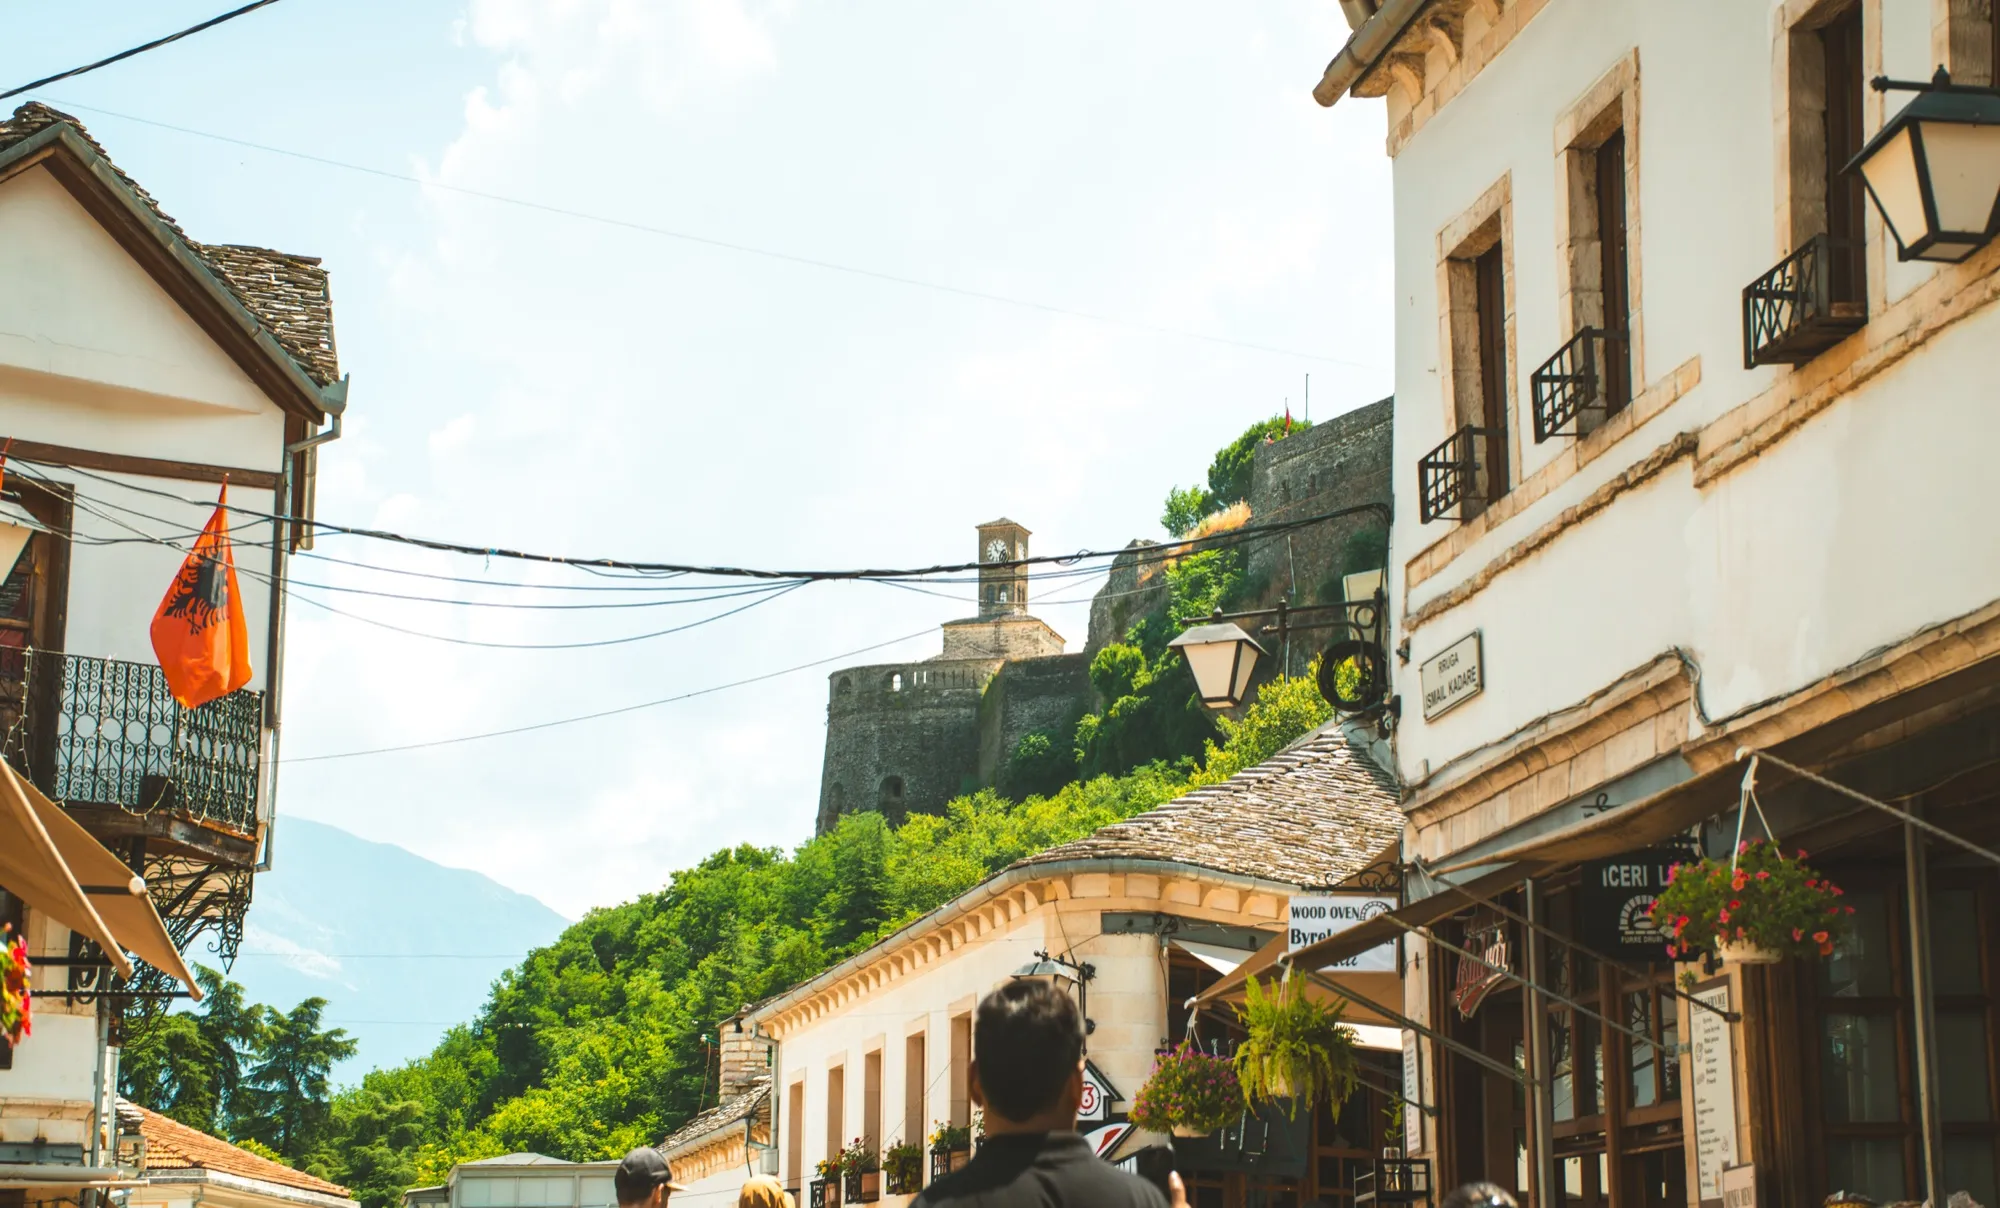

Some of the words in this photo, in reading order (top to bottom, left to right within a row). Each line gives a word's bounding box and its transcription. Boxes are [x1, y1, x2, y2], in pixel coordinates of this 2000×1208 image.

[1438, 652, 1459, 674] RRUGA
[1425, 685, 1447, 710] ISMAIL
[1448, 665, 1476, 696] KADARE
[1291, 906, 1326, 919] WOOD
[1330, 906, 1360, 919] OVEN
